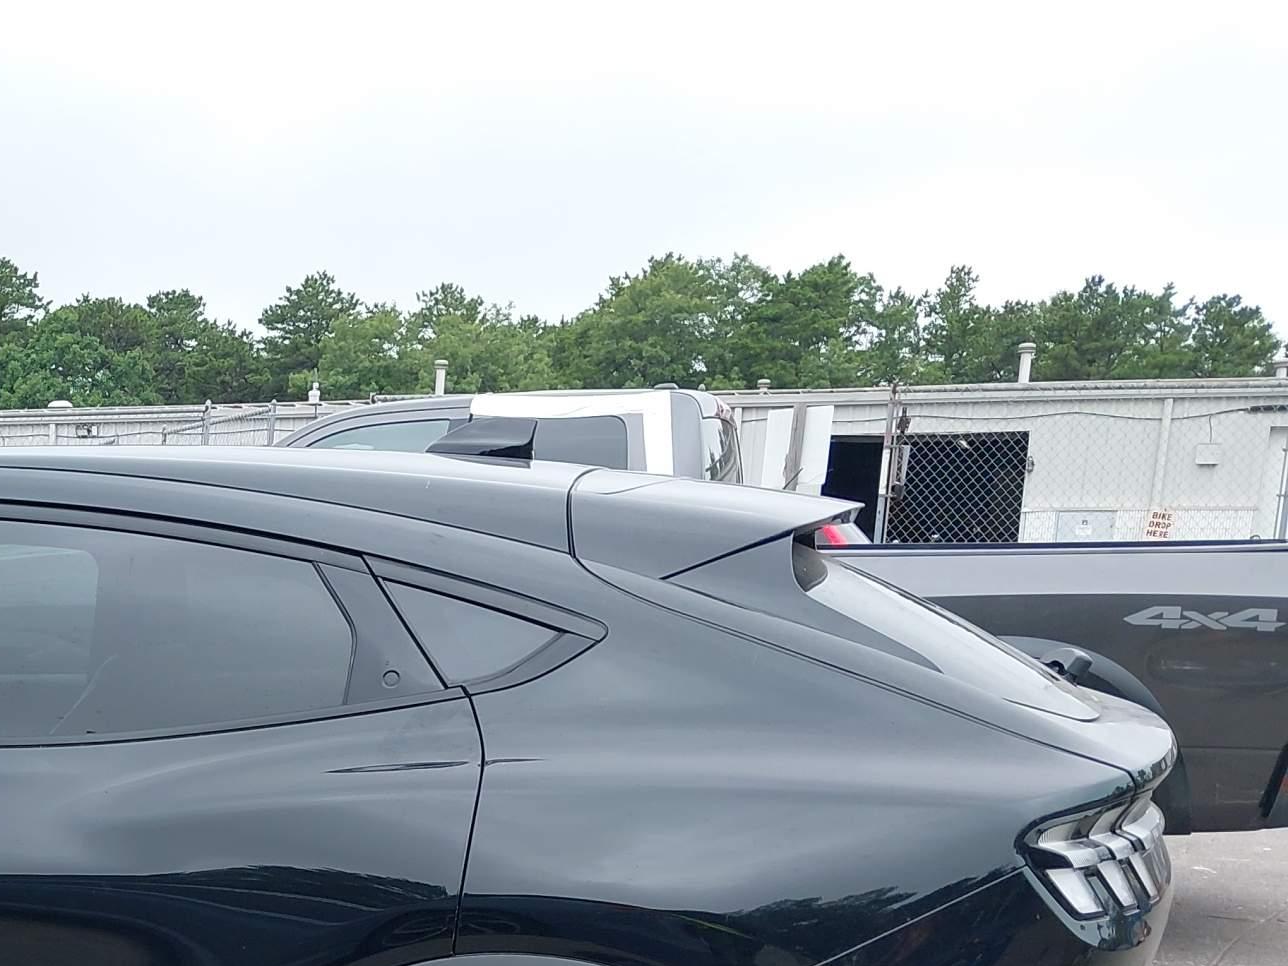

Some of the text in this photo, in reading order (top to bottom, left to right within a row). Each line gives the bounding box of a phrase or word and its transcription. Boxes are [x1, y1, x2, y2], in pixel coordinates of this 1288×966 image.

[1152, 511, 1173, 521] BIKE
[1148, 520, 1172, 530] DROP
[1145, 529, 1169, 539] HERE
